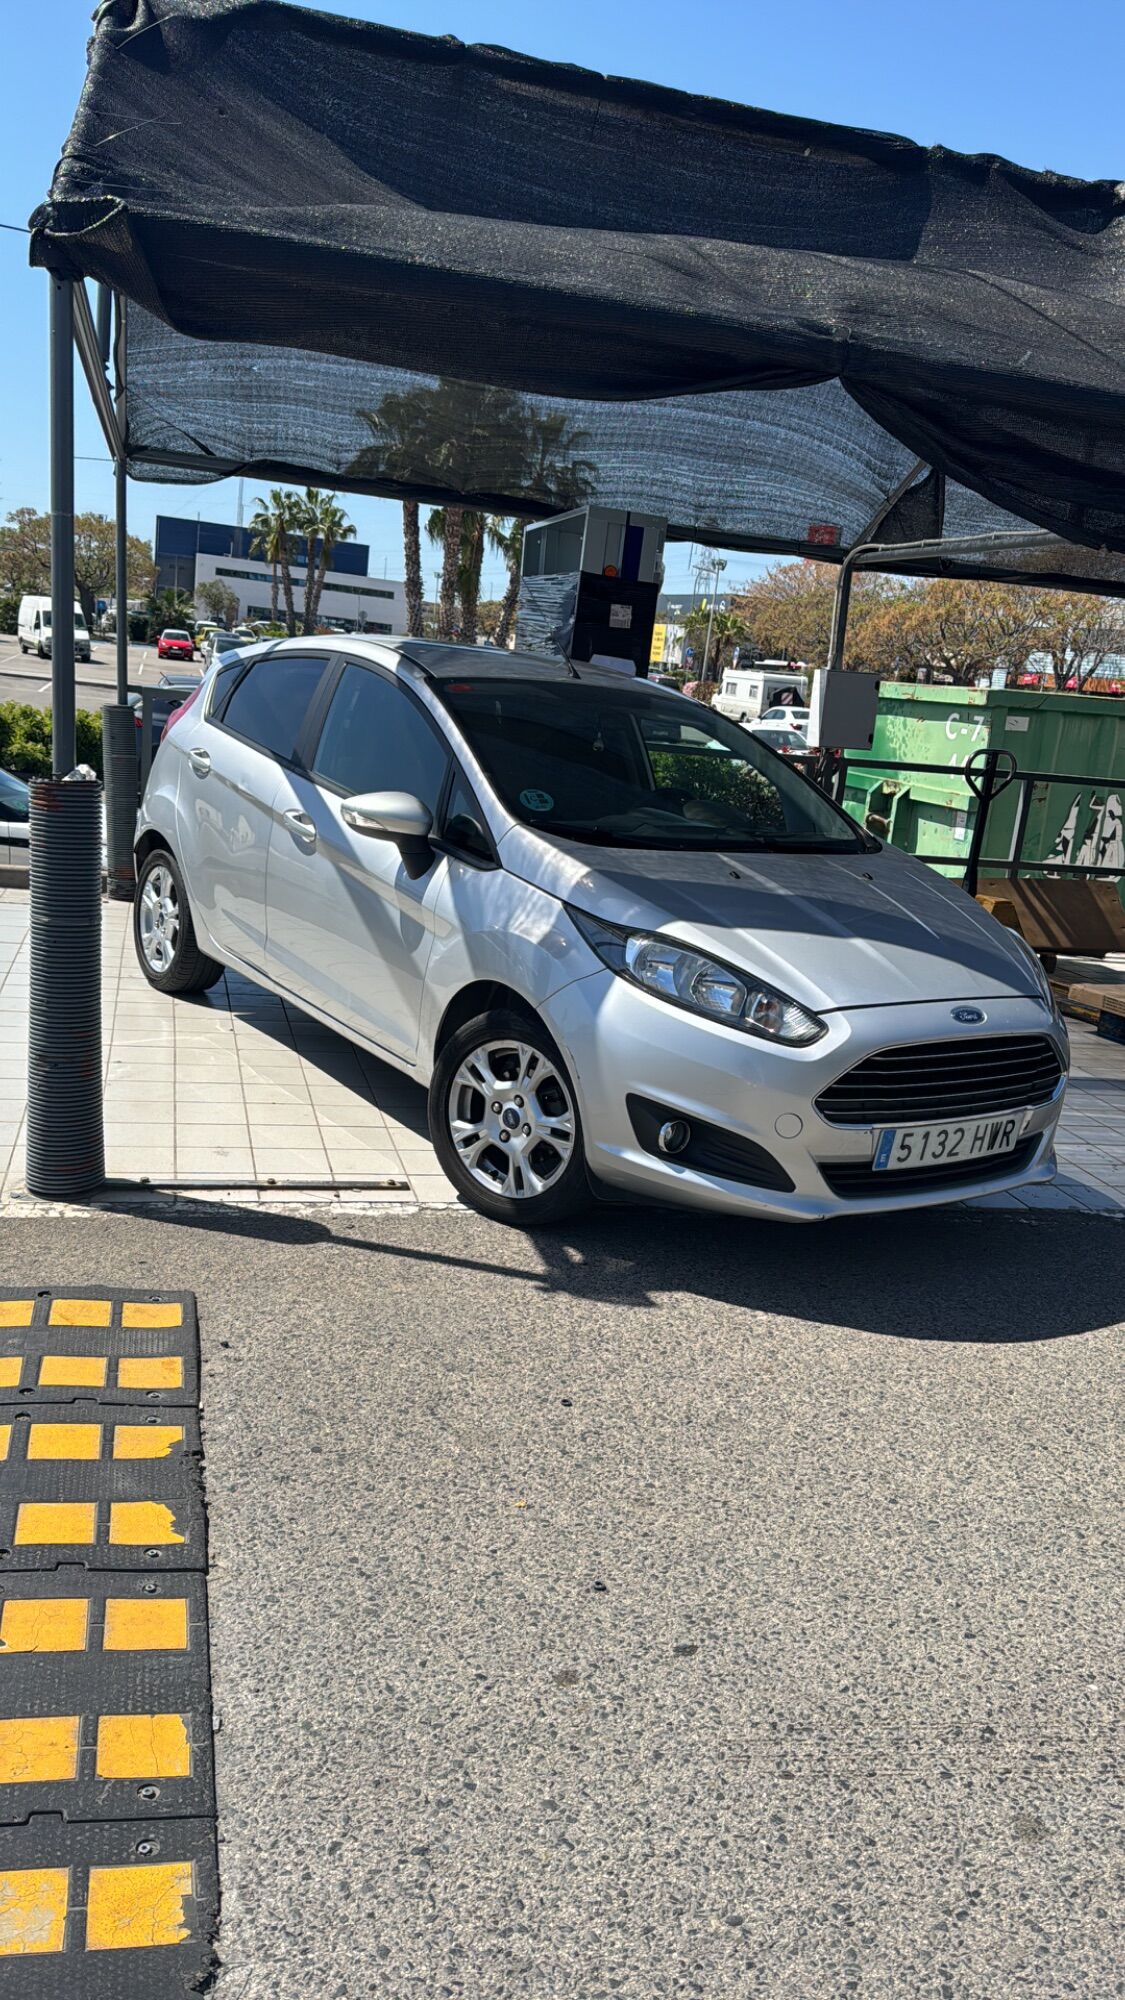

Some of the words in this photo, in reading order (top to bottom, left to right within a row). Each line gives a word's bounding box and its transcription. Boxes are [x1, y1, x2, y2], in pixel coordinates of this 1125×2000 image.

[945, 712, 985, 742] C-7
[896, 1127, 965, 1163] 5132
[970, 1119, 1016, 1154] HWR
